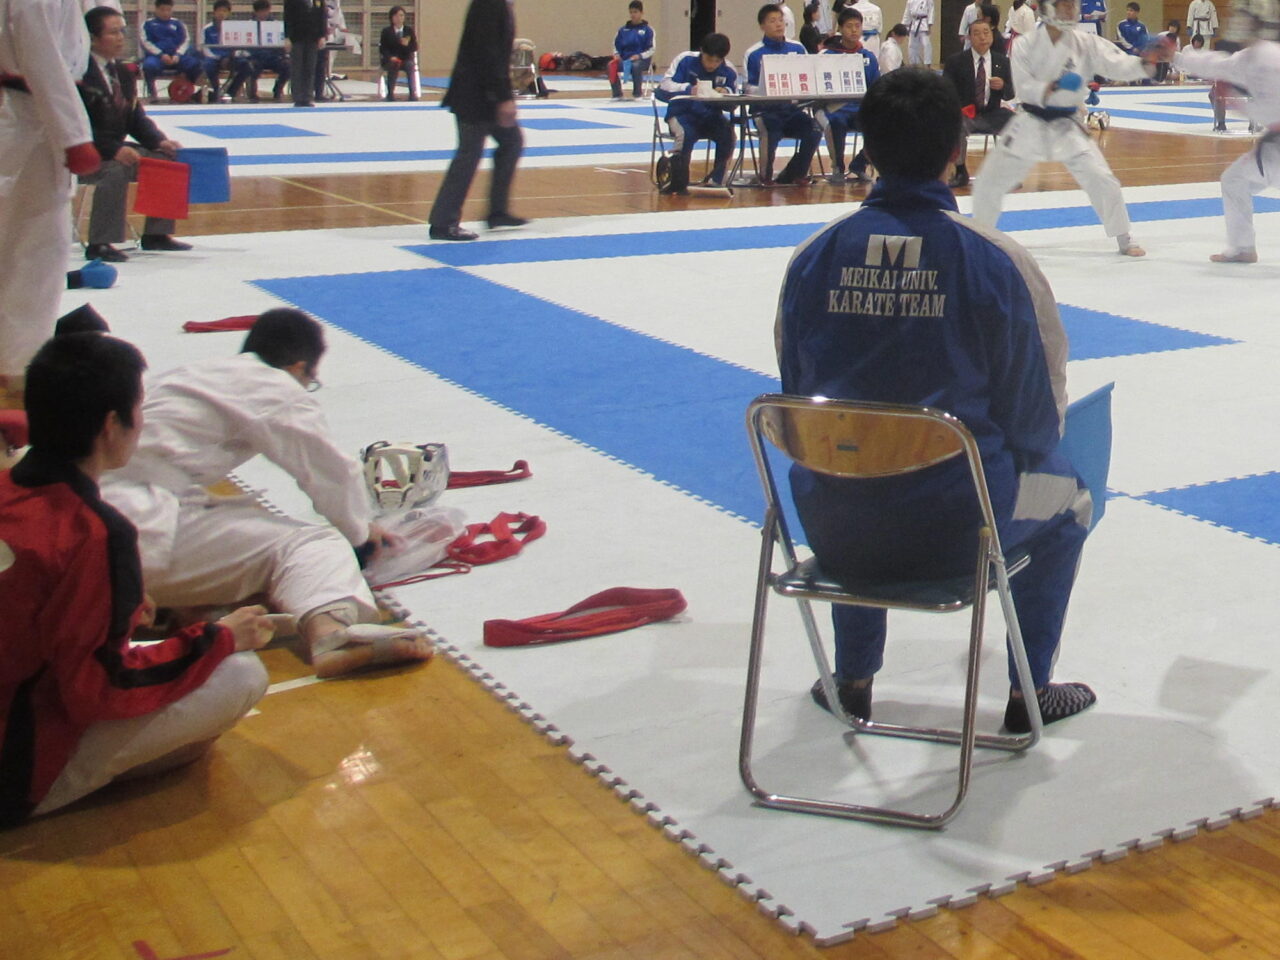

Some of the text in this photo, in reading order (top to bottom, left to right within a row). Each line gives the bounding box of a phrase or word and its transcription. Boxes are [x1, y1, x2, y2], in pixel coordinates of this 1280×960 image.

[865, 234, 922, 268] M
[840, 267, 939, 290] MEIKAI UNIV.
[827, 290, 946, 317] KARATE TEAM
